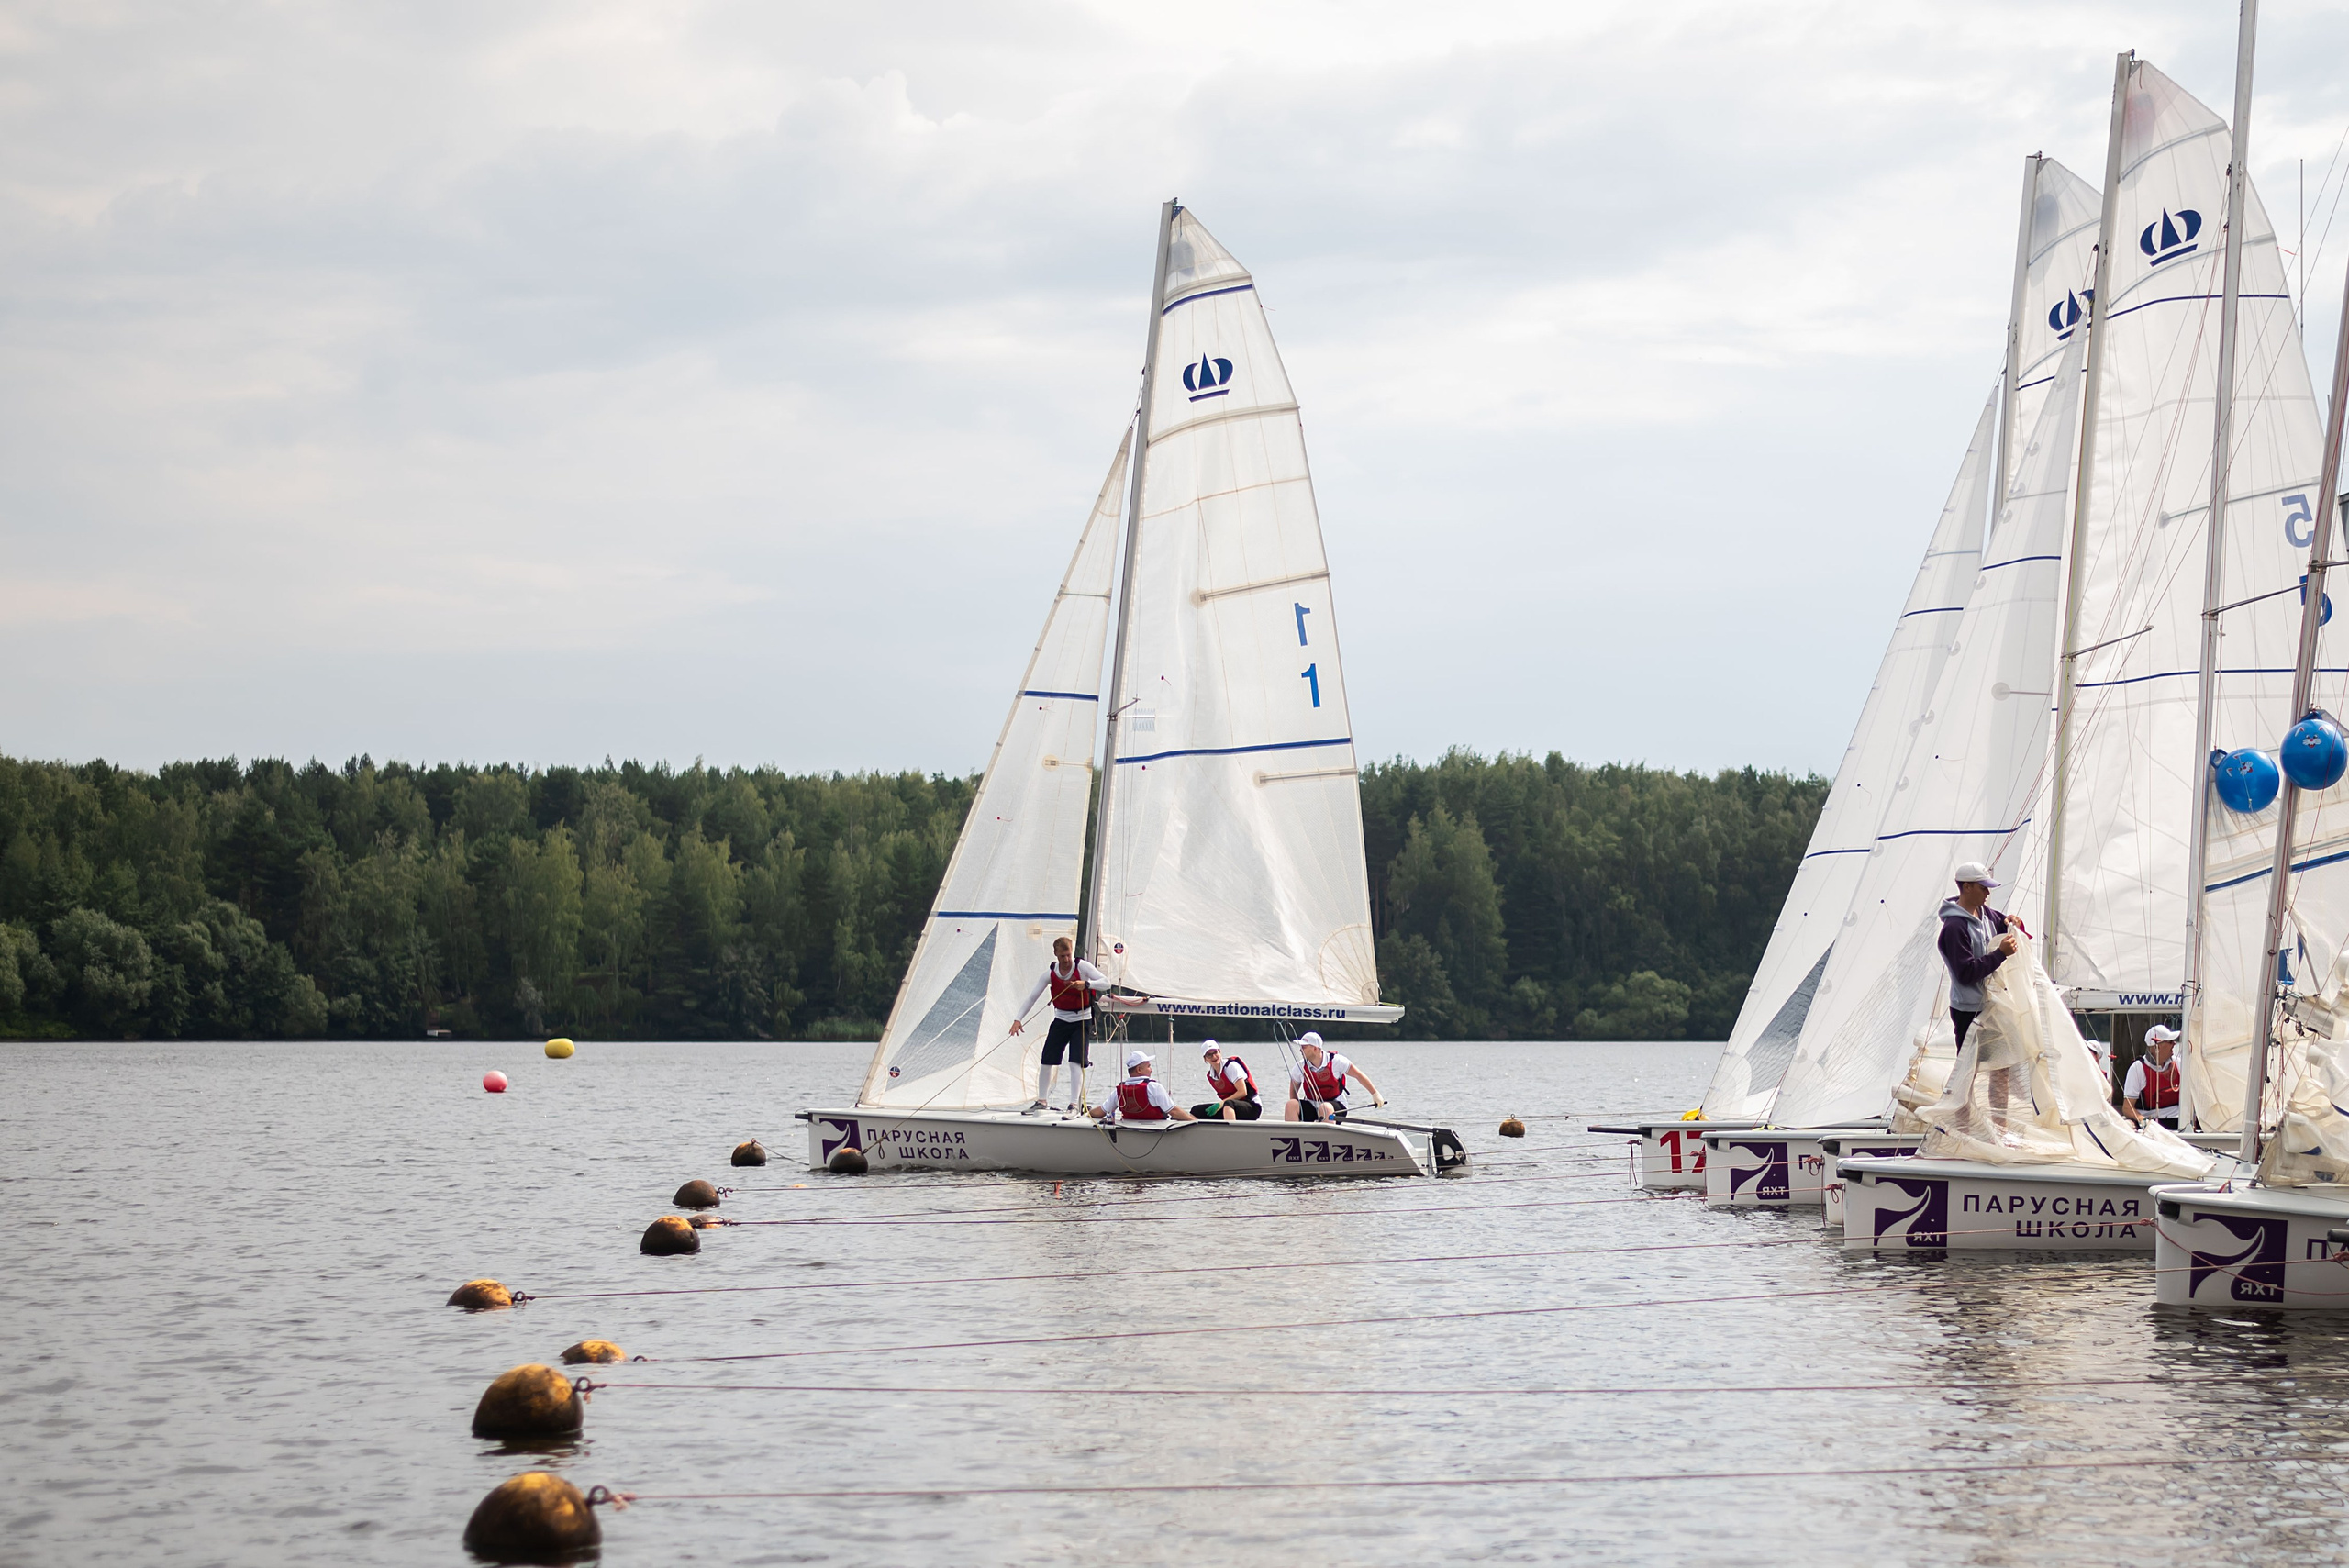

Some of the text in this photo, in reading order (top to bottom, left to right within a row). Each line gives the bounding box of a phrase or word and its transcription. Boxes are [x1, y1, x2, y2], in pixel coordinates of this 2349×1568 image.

[1301, 663, 1320, 707] 1
[1157, 1002, 1346, 1018] www.nationalclass.ru
[867, 1129, 965, 1144] ПАРУСНАЯ
[899, 1147, 970, 1160] ШКОЛА
[1660, 1130, 1710, 1173] 17
[1762, 1186, 1786, 1195] ЯХТ
[1963, 1194, 2140, 1217] ПАРУСНАЯ
[2016, 1220, 2137, 1239] ШКОЛА
[2240, 1281, 2278, 1296] ЯХТ
